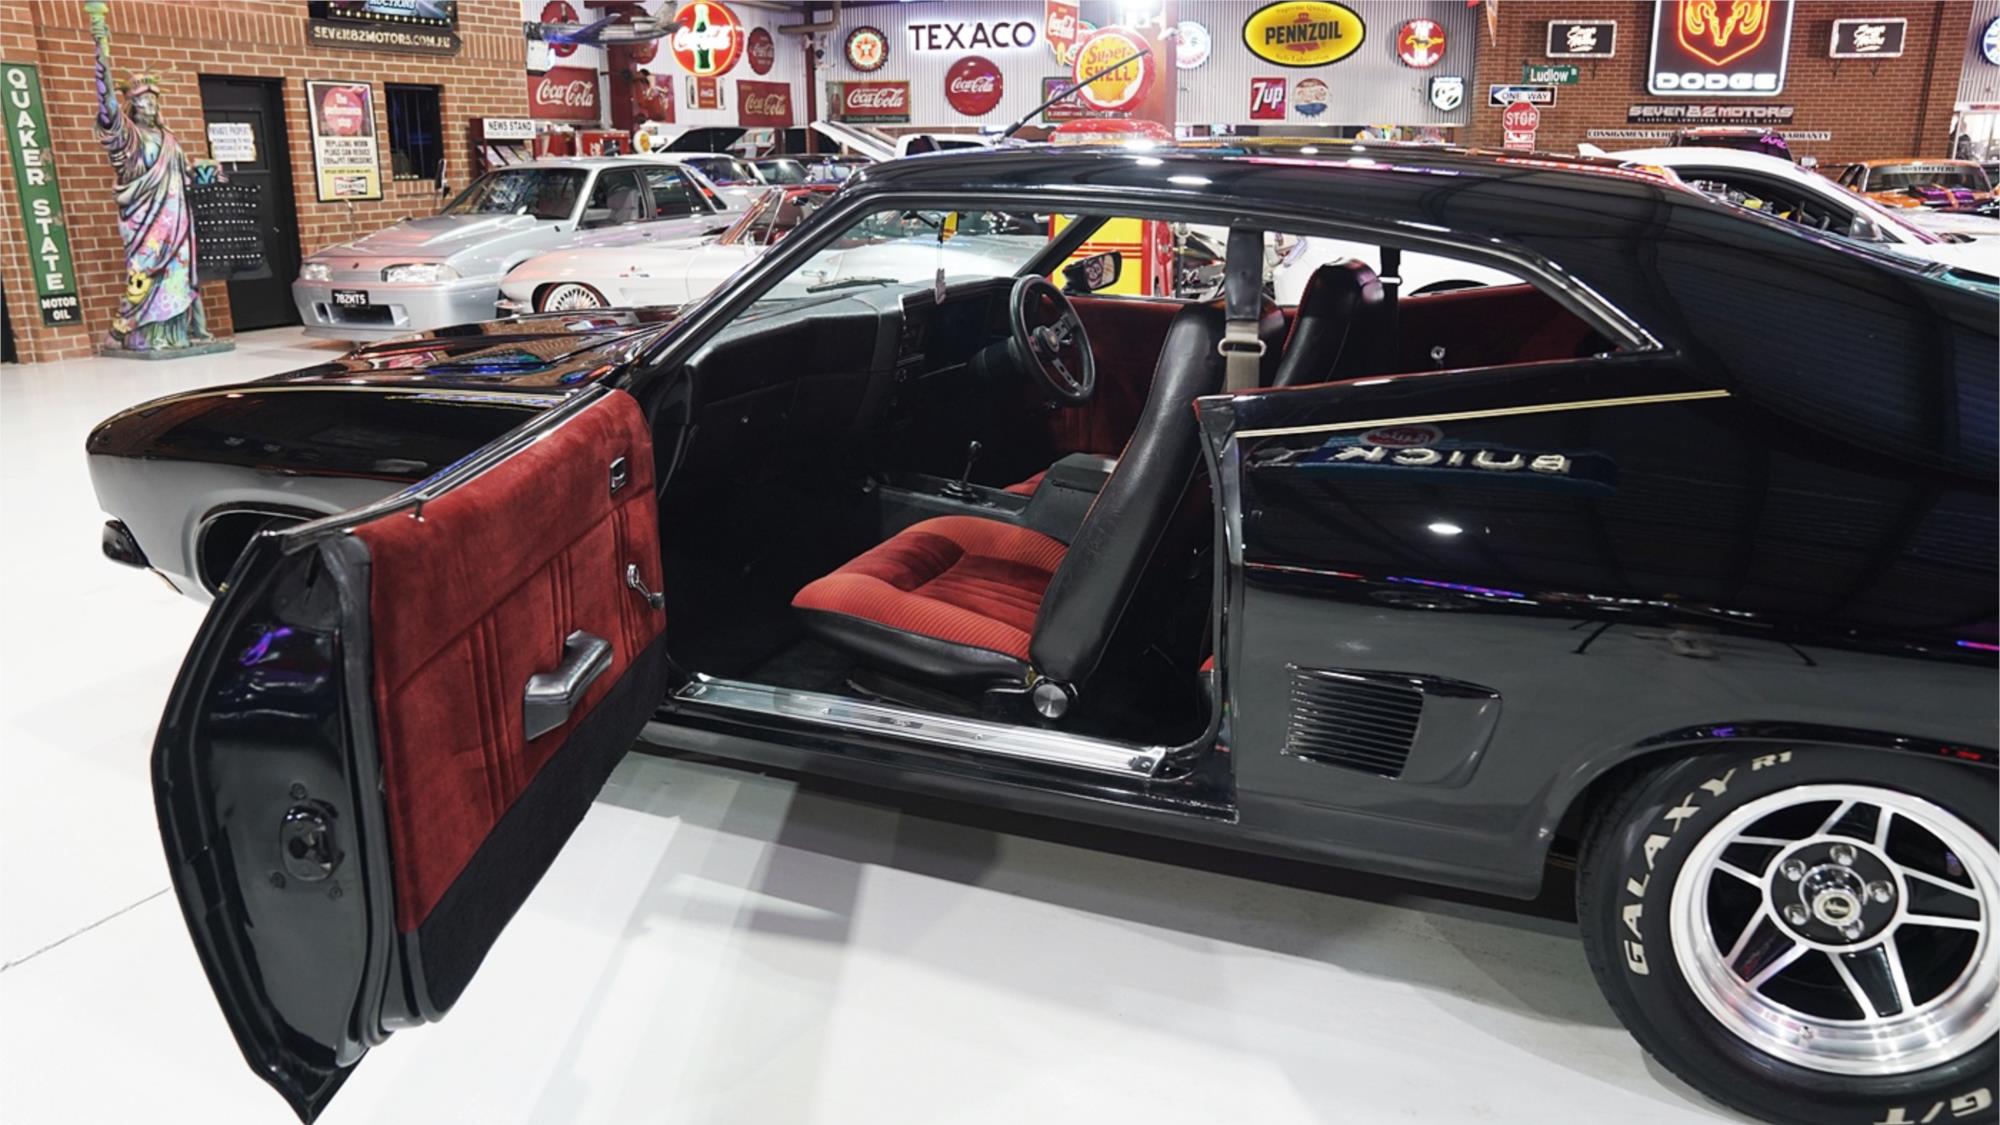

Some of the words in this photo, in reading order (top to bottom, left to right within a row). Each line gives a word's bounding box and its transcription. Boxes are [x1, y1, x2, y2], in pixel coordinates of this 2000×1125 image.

[908, 22, 1036, 50] TEXACO
[1265, 21, 1342, 45] PENNZOIL
[1086, 45, 1130, 65] Super
[1085, 65, 1132, 82] SHELL
[1530, 68, 1569, 82] Ludlow
[1656, 72, 1778, 90] DODGE
[536, 78, 593, 107] Coca-Cola
[951, 76, 995, 93] Coca-Cola
[745, 93, 786, 116] Coca-Cola
[847, 87, 904, 108] Coca-Cola
[1502, 91, 1520, 100] ONE
[1528, 91, 1548, 100] WAY
[1505, 112, 1537, 126] STOP
[1629, 106, 1686, 117] SEVEN
[1687, 105, 1717, 118] 82
[1718, 106, 1794, 118] MOTORS
[7, 68, 45, 186] QUAKER
[488, 120, 508, 131] NEWS
[509, 120, 532, 131] STAND
[32, 199, 65, 290] STATE
[41, 297, 77, 309] MOTOR
[53, 310, 71, 320] OIL
[1623, 768, 1737, 976] GALAXY
[1751, 751, 1793, 771] R1
